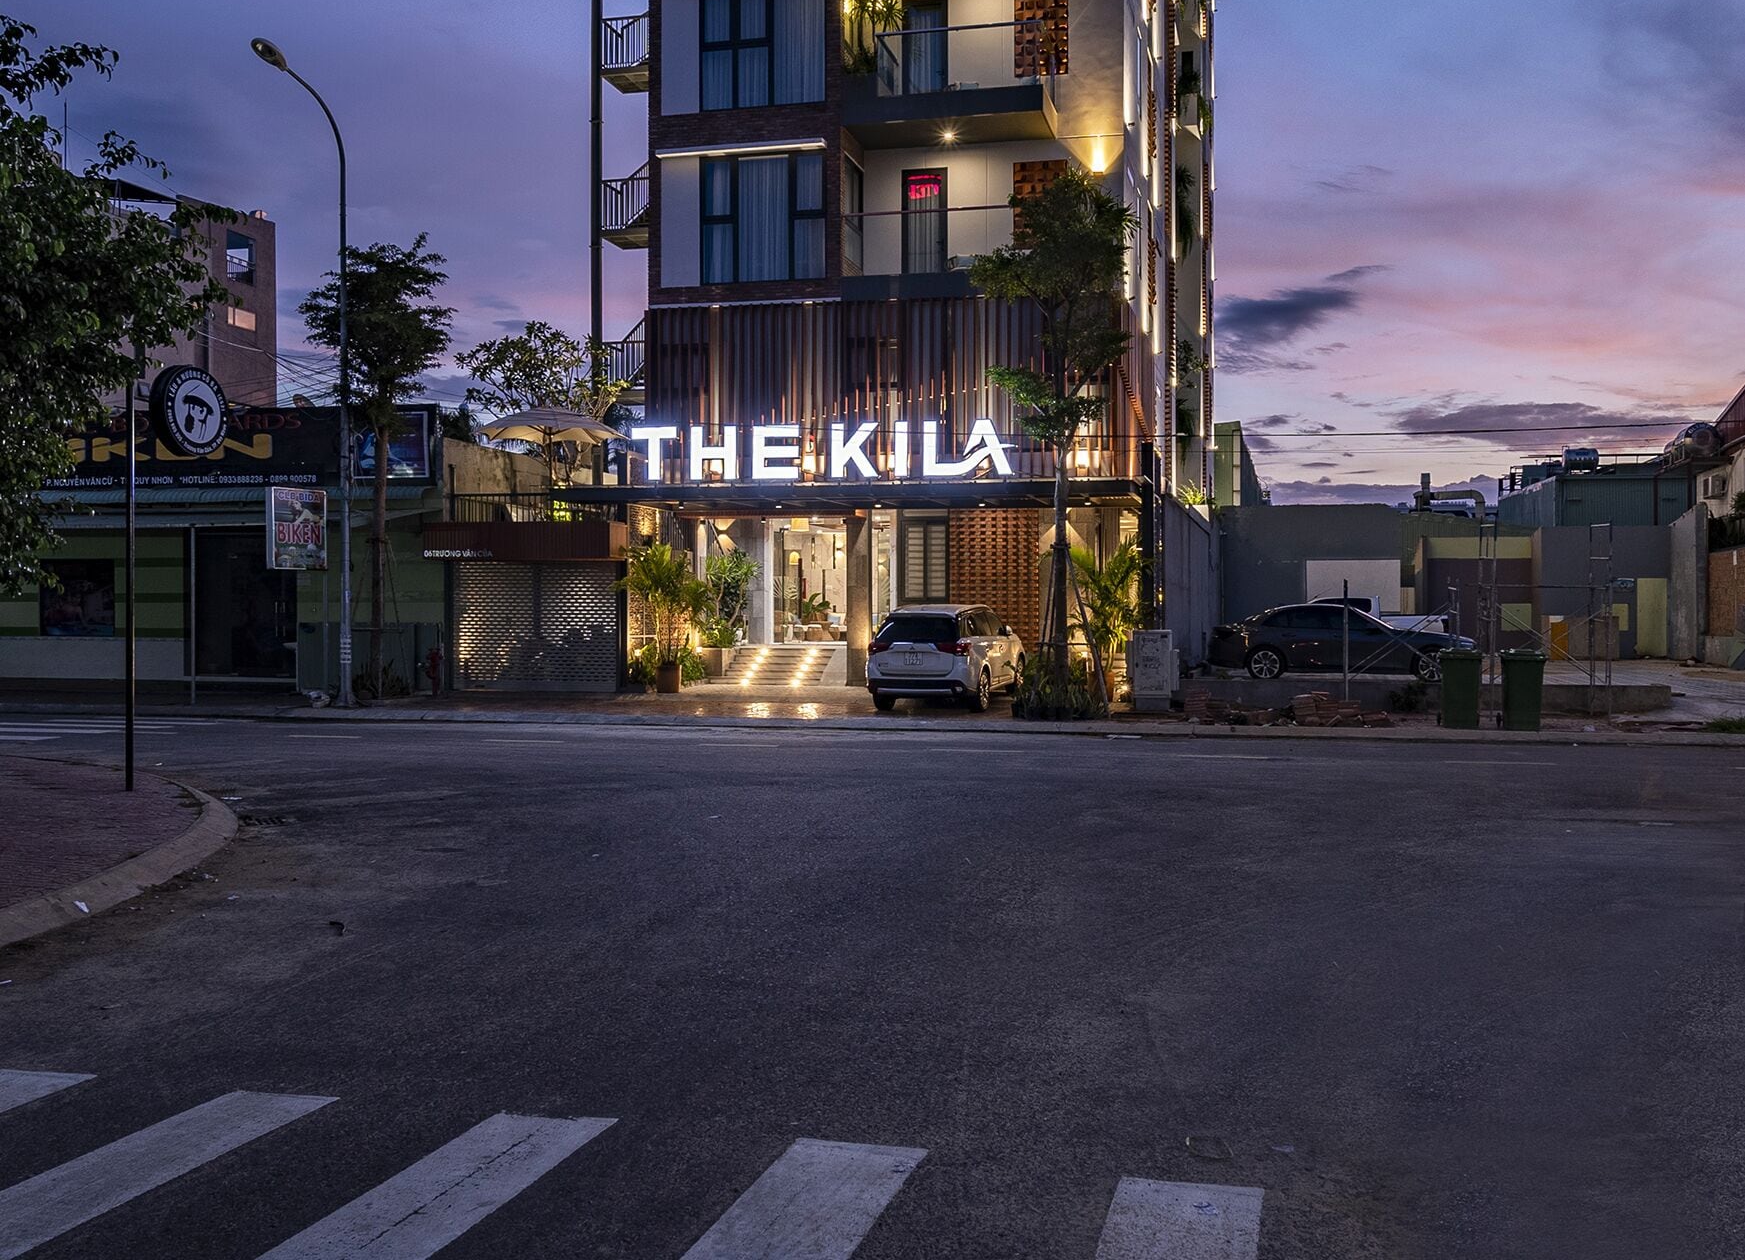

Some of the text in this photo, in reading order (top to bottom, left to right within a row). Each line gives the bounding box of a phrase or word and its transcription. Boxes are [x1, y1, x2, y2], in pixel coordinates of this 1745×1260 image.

[631, 418, 1019, 481] THE KILA
[276, 522, 322, 544] BIKEN
